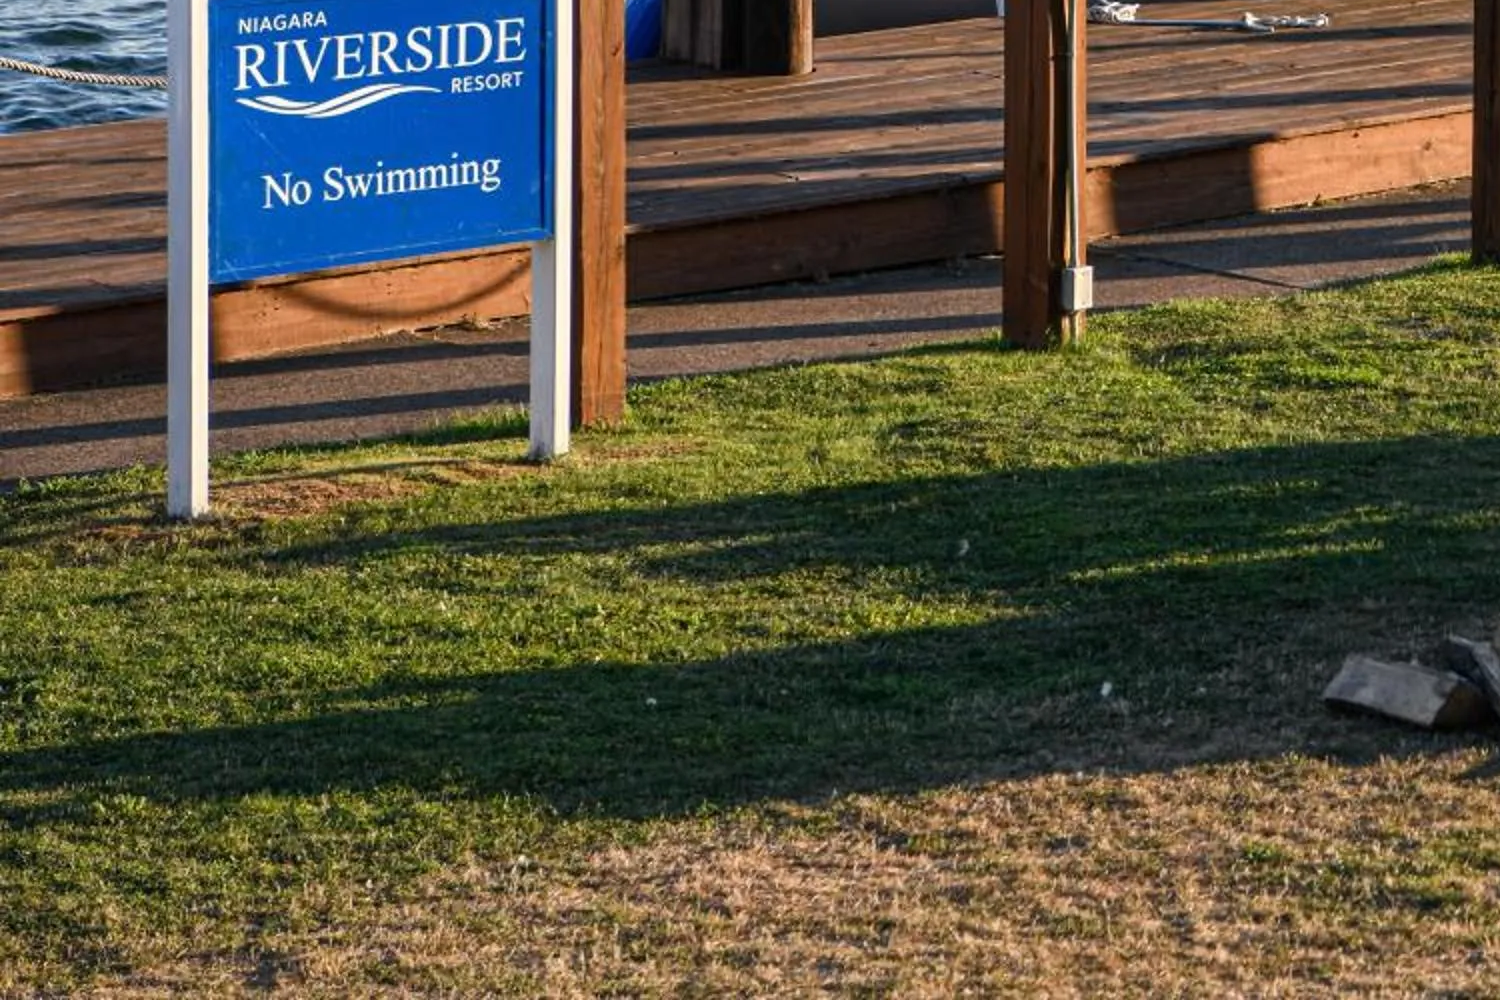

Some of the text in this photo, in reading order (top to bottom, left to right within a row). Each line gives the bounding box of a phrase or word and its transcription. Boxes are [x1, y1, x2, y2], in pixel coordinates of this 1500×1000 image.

[238, 11, 328, 34] NIAGARA
[233, 17, 527, 91] RIVERSIDE
[450, 71, 524, 94] RESORT
[262, 152, 501, 209] No Swimming
